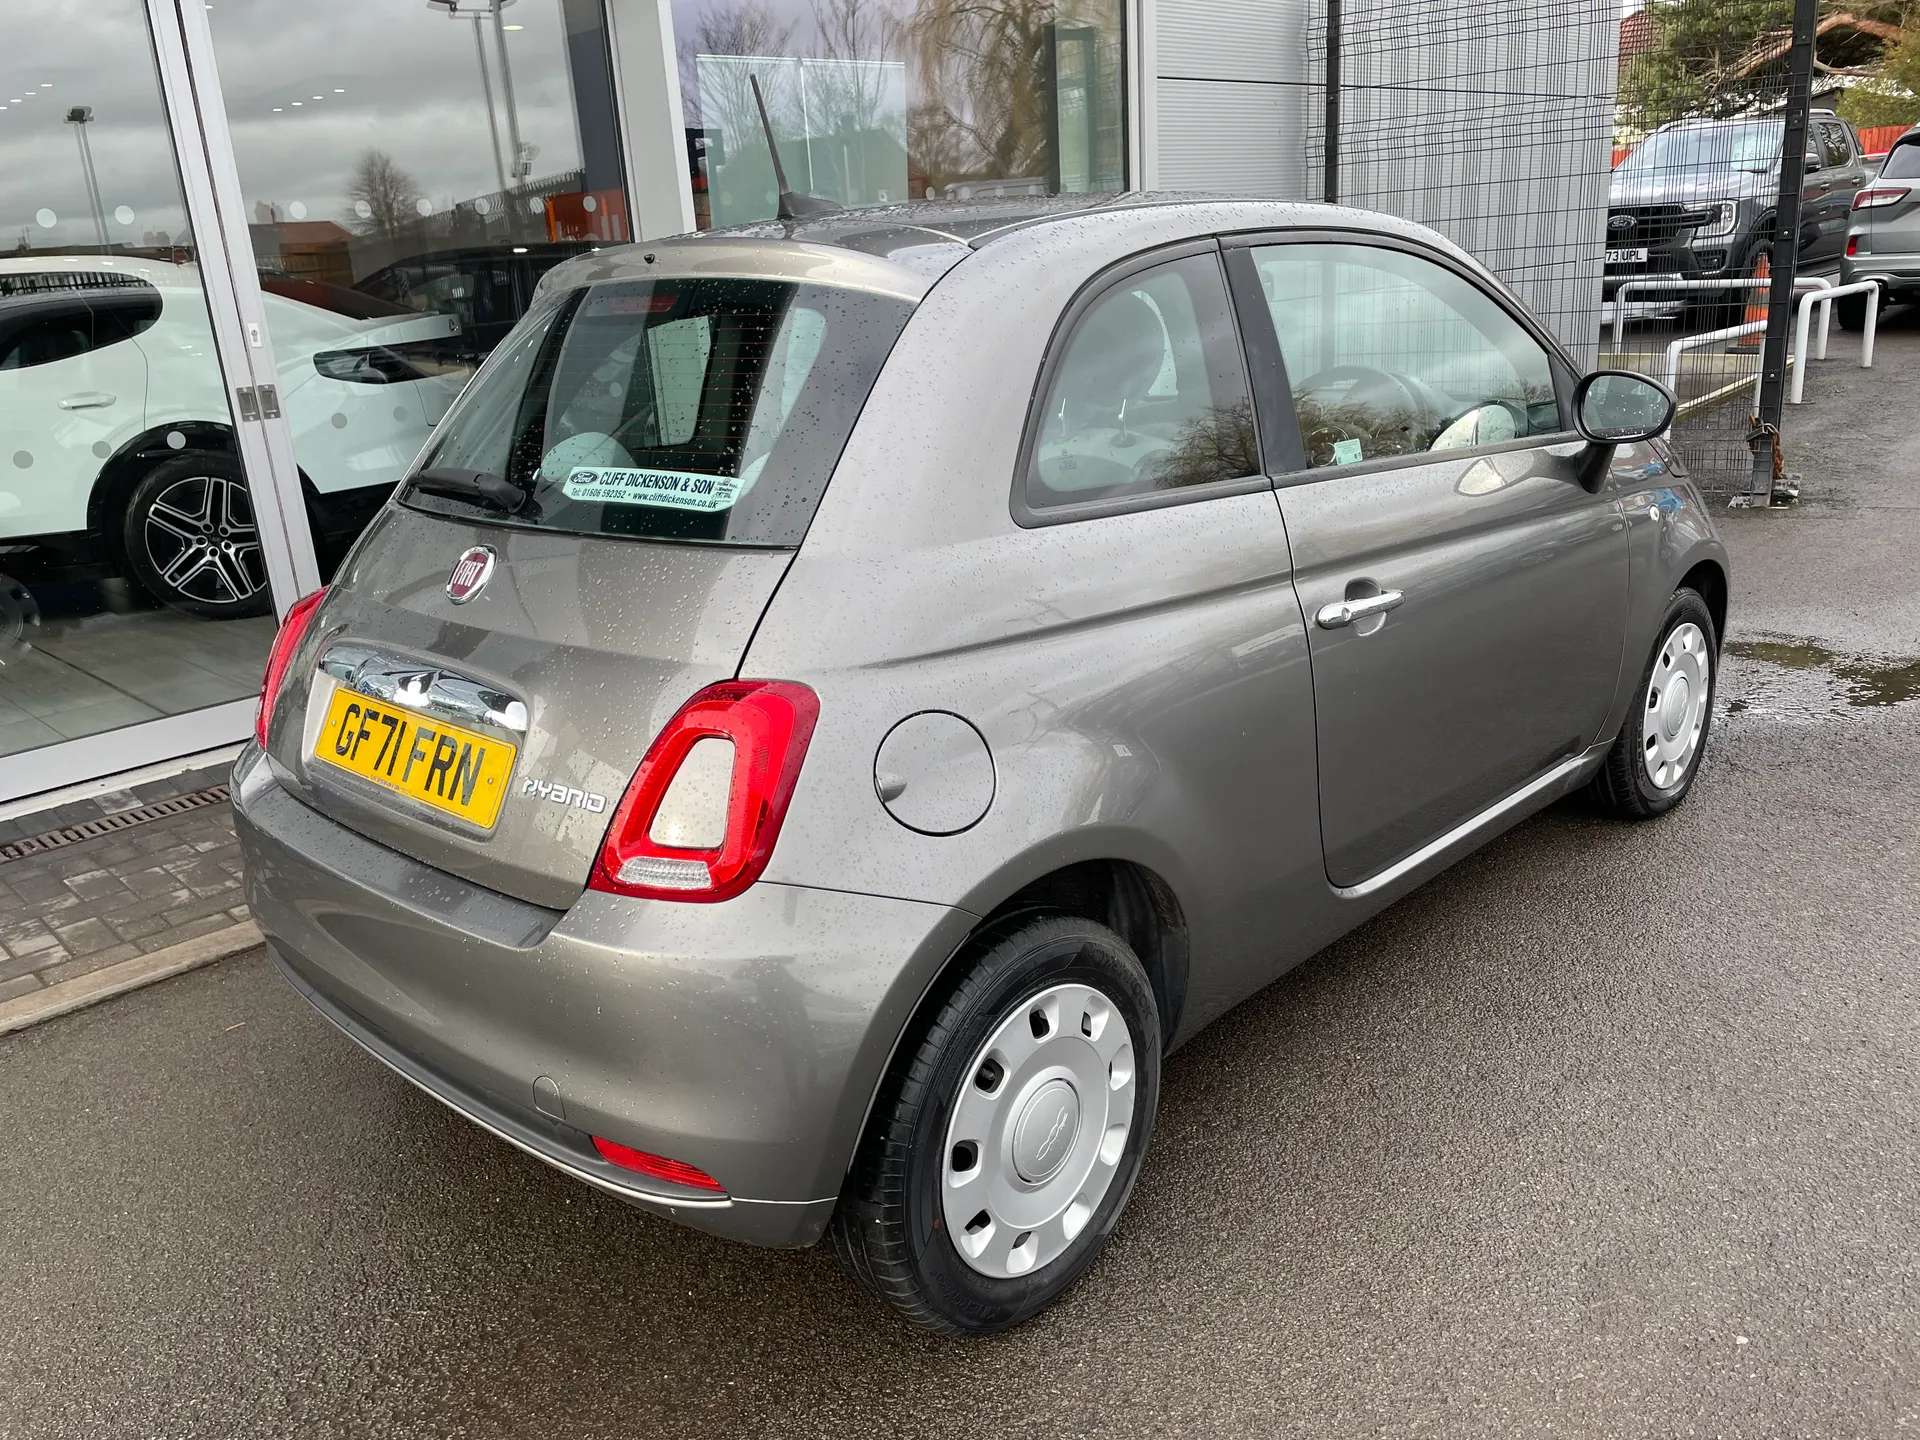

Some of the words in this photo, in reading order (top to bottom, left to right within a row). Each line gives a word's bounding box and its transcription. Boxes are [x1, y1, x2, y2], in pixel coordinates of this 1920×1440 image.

[1622, 250, 1643, 261] UPL
[600, 471, 627, 486] CLIFF
[625, 472, 681, 491] DICKENSON
[680, 477, 690, 492] &
[691, 478, 715, 495] SON
[632, 492, 718, 509] www.cliffdickenson.co.uk
[453, 559, 485, 588] FIAT
